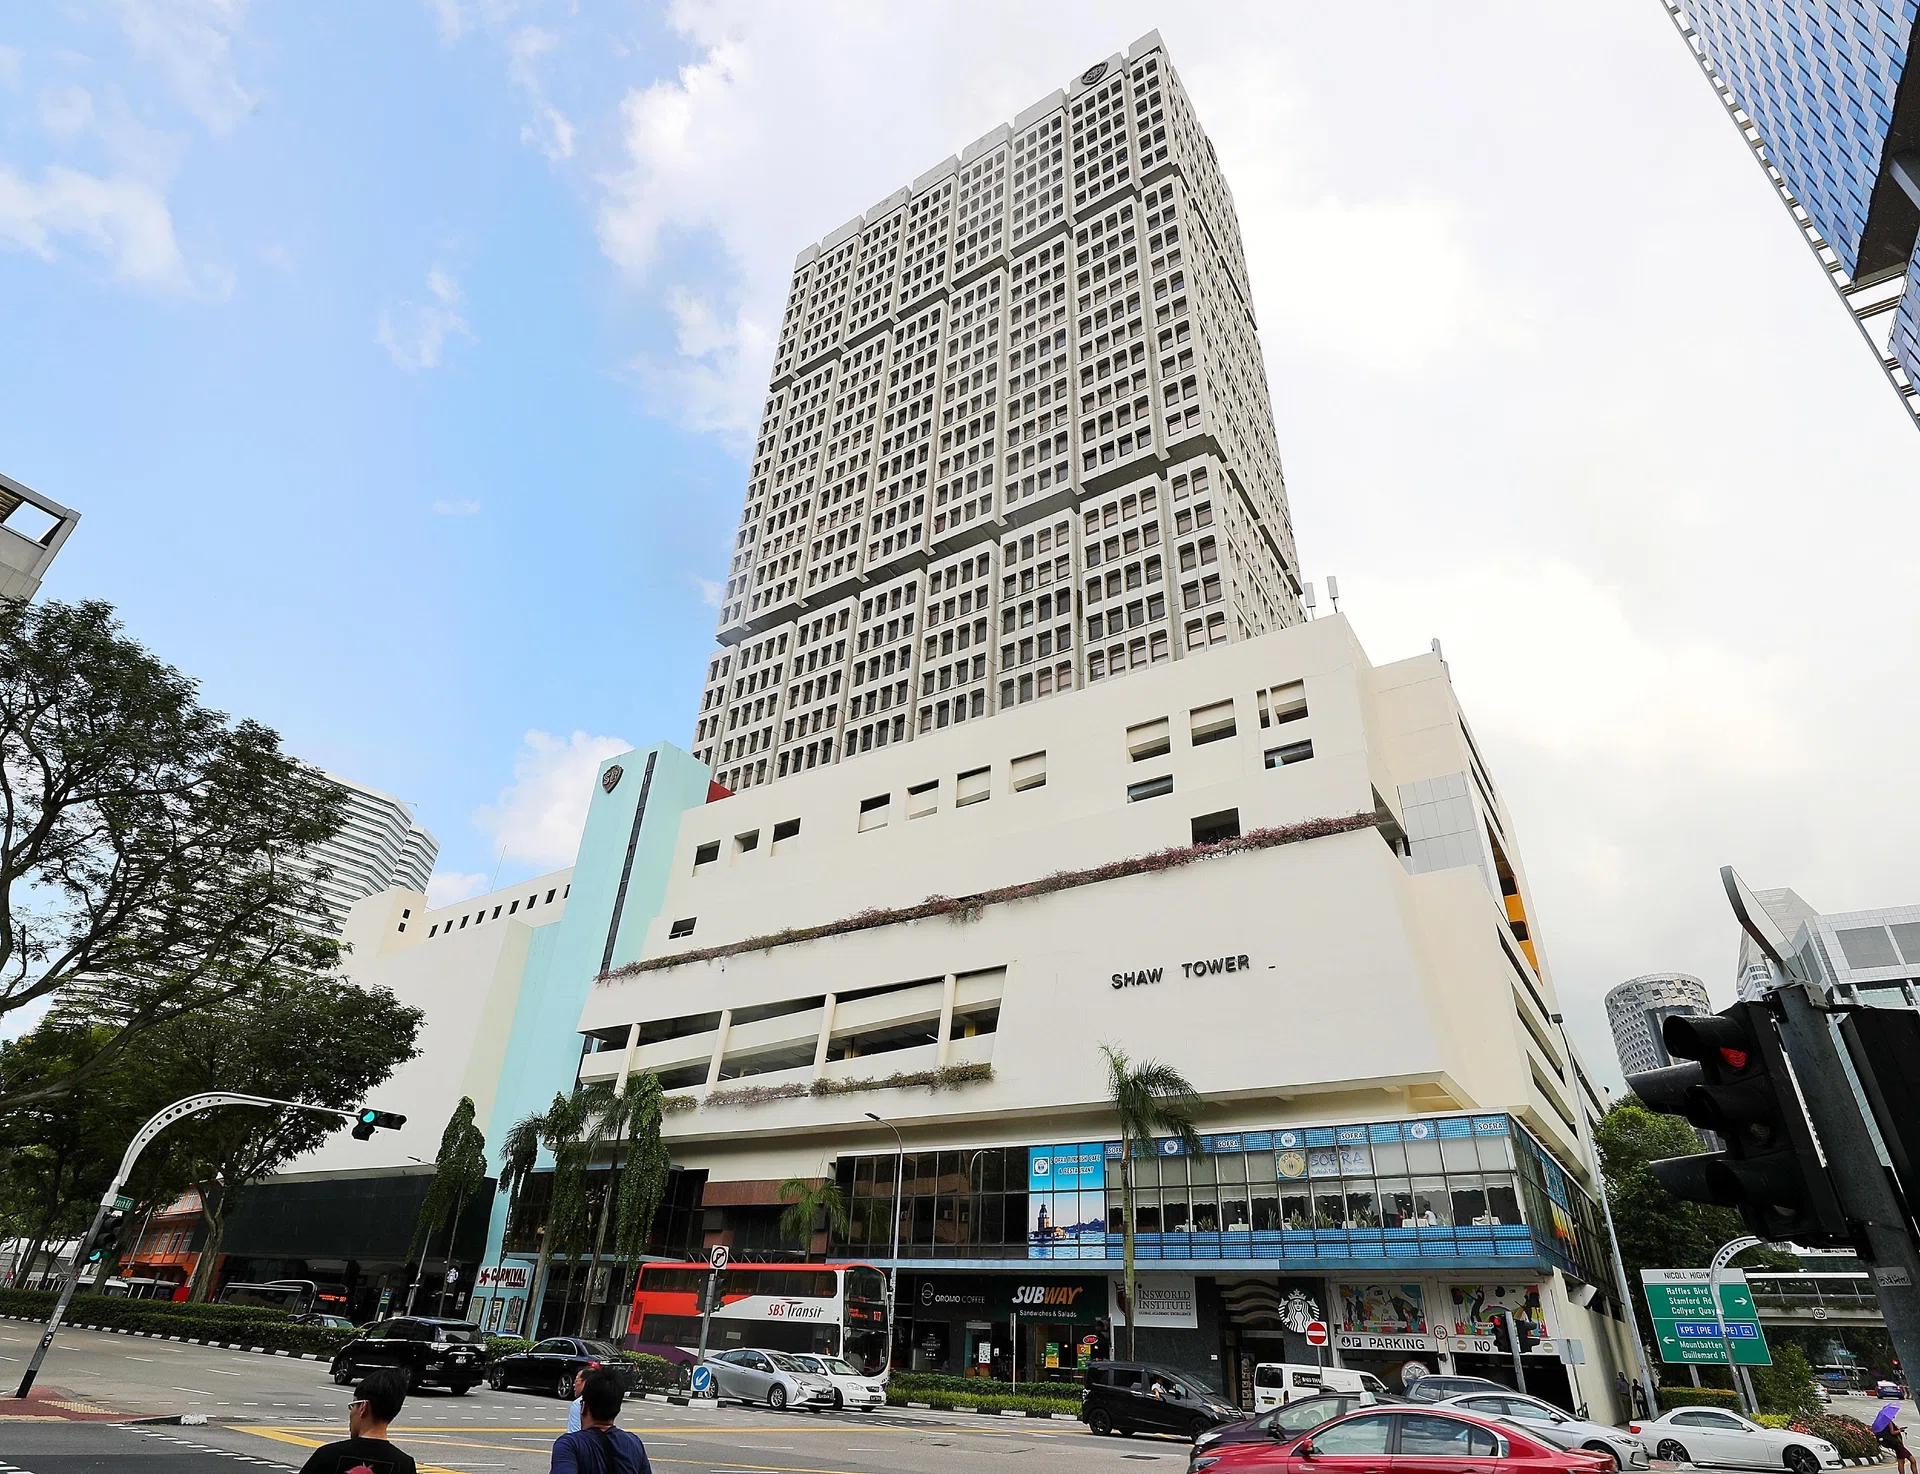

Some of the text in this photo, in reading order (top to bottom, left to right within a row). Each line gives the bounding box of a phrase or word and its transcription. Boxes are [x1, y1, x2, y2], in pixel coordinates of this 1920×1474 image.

[1111, 954, 1250, 990] SHAW TOWER
[1478, 1122, 1503, 1131] SOFRA
[1341, 1131, 1363, 1139] SOFRA
[1218, 1140, 1239, 1148] SOFRA
[1311, 1151, 1365, 1167] SOFRA
[491, 1268, 527, 1282] CARNIVAL
[1663, 1271, 1687, 1279] NICOLL
[1012, 1286, 1083, 1305] SUBWAY
[1693, 1287, 1708, 1295] Blvd
[935, 1294, 986, 1304] OROMO COFFEE
[1669, 1297, 1713, 1305] Stamford Rd
[768, 1301, 824, 1318] SBS Transit
[1138, 1300, 1192, 1310] INSTITUTE
[1019, 1309, 1052, 1318] Sandwiches
[1057, 1310, 1077, 1318] Salads
[1671, 1307, 1716, 1316] Collyer Quay
[1680, 1326, 1695, 1334] KPE
[1697, 1325, 1711, 1335] (PIE
[1725, 1326, 1738, 1335] PE)
[1369, 1337, 1426, 1350] PARKING
[1474, 1341, 1492, 1353] NO
[1679, 1341, 1723, 1349] Mountbatten
[1682, 1351, 1718, 1359] Guillemard
